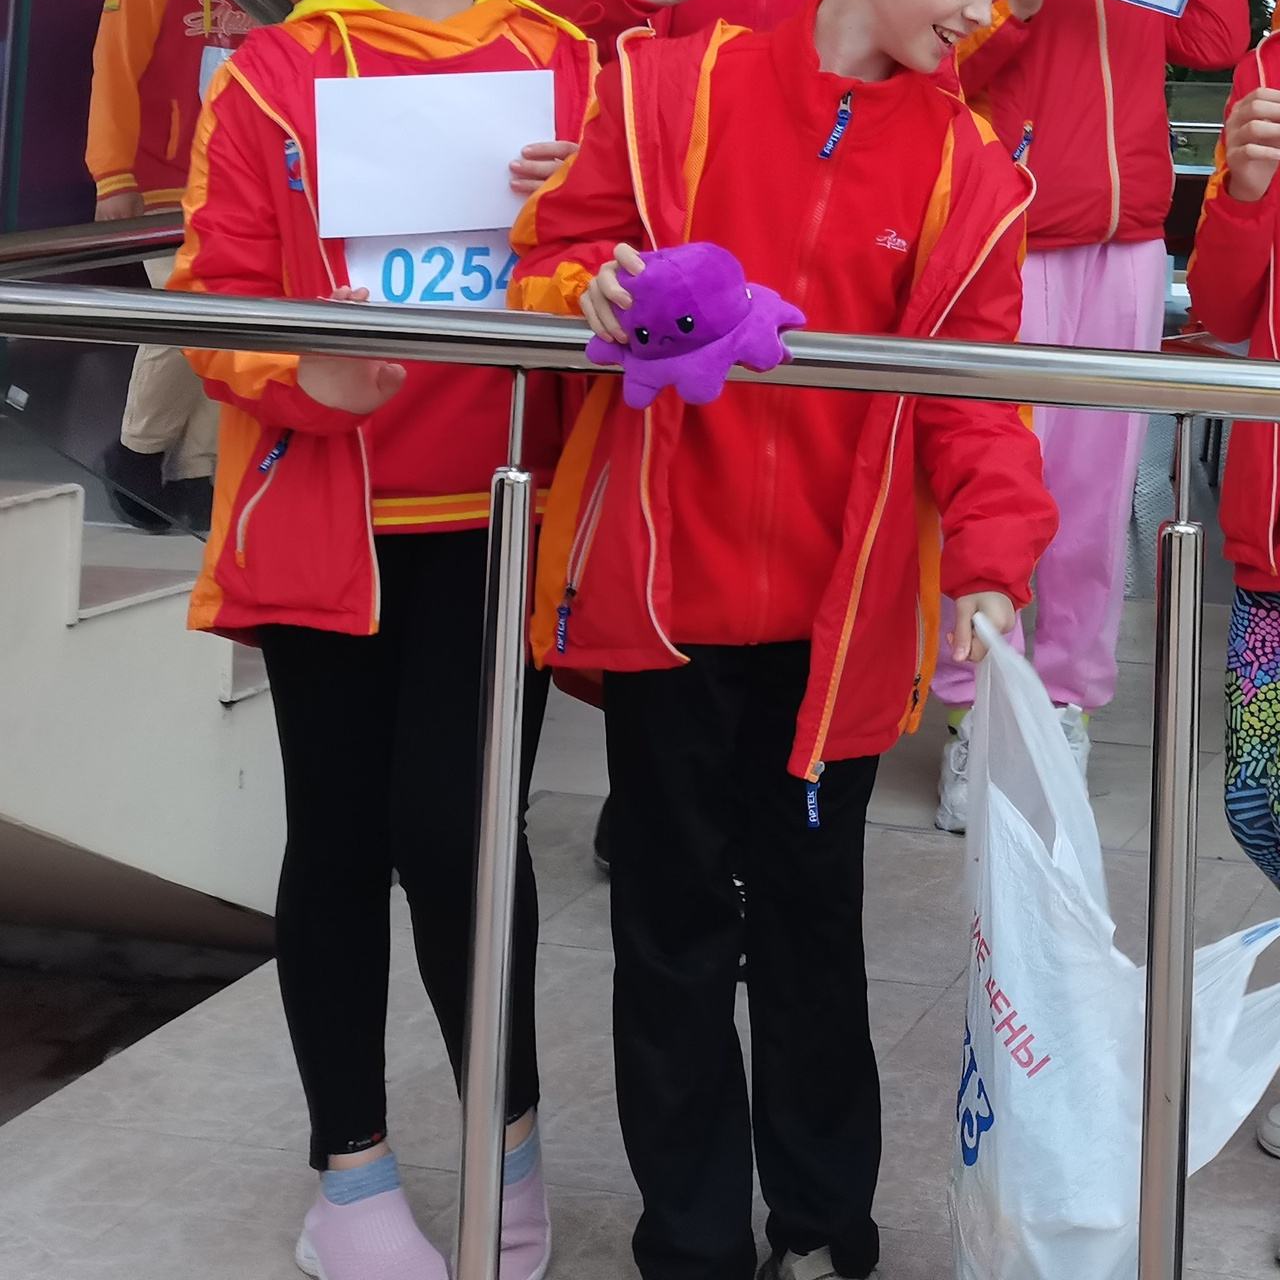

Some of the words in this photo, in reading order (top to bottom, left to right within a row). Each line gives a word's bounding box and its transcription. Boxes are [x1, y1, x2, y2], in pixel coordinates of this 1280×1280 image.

[823, 123, 845, 154] АРТЕК
[807, 790, 817, 822] АРТЕК
[984, 975, 1052, 1080] ЕНЫ
